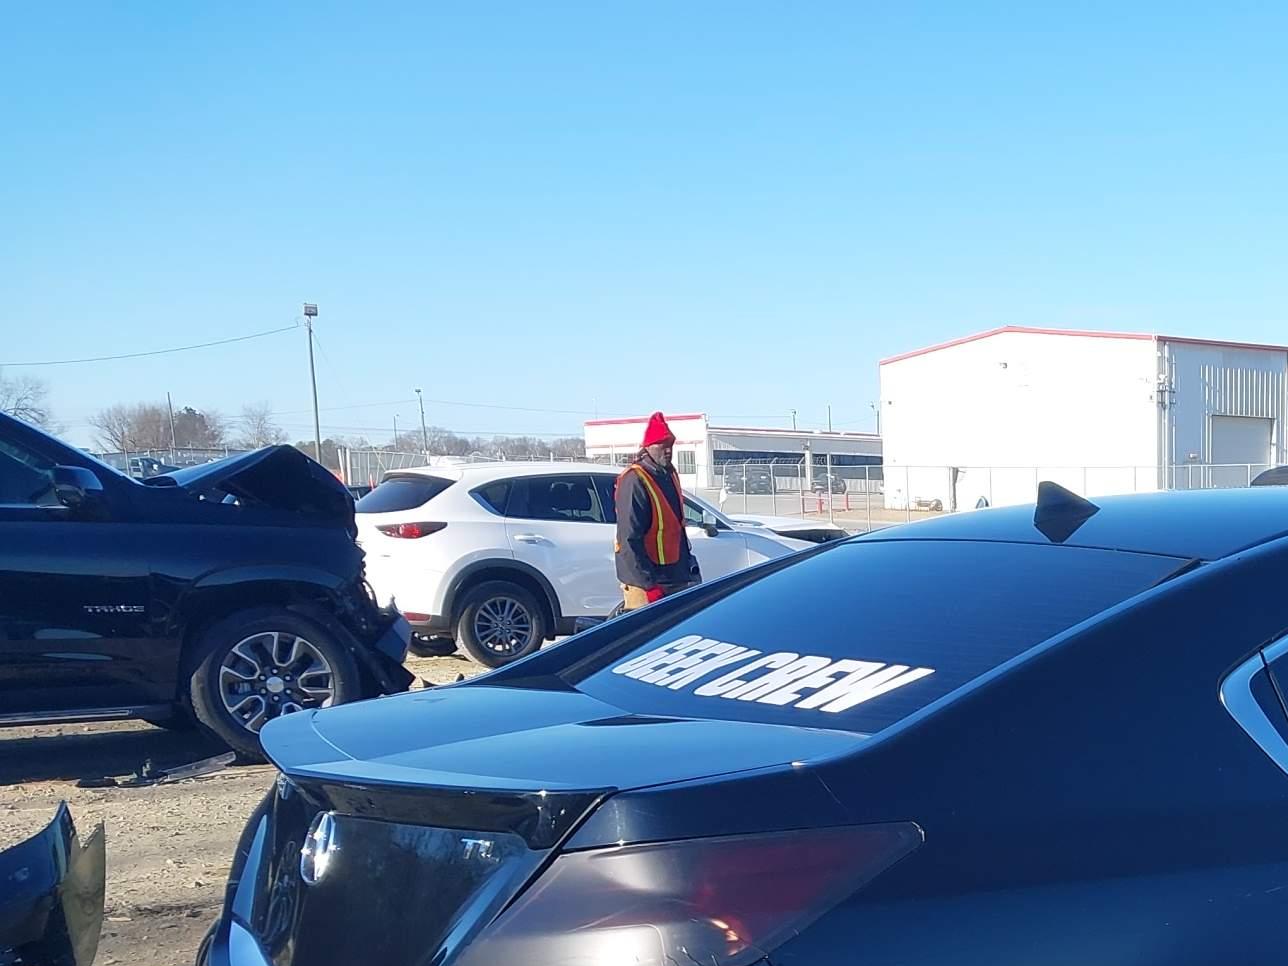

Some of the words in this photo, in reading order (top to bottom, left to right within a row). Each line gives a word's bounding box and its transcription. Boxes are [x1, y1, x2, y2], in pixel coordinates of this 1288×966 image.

[83, 604, 145, 613] TAHOE
[612, 635, 762, 690] GEEK
[693, 652, 936, 713] CREW
